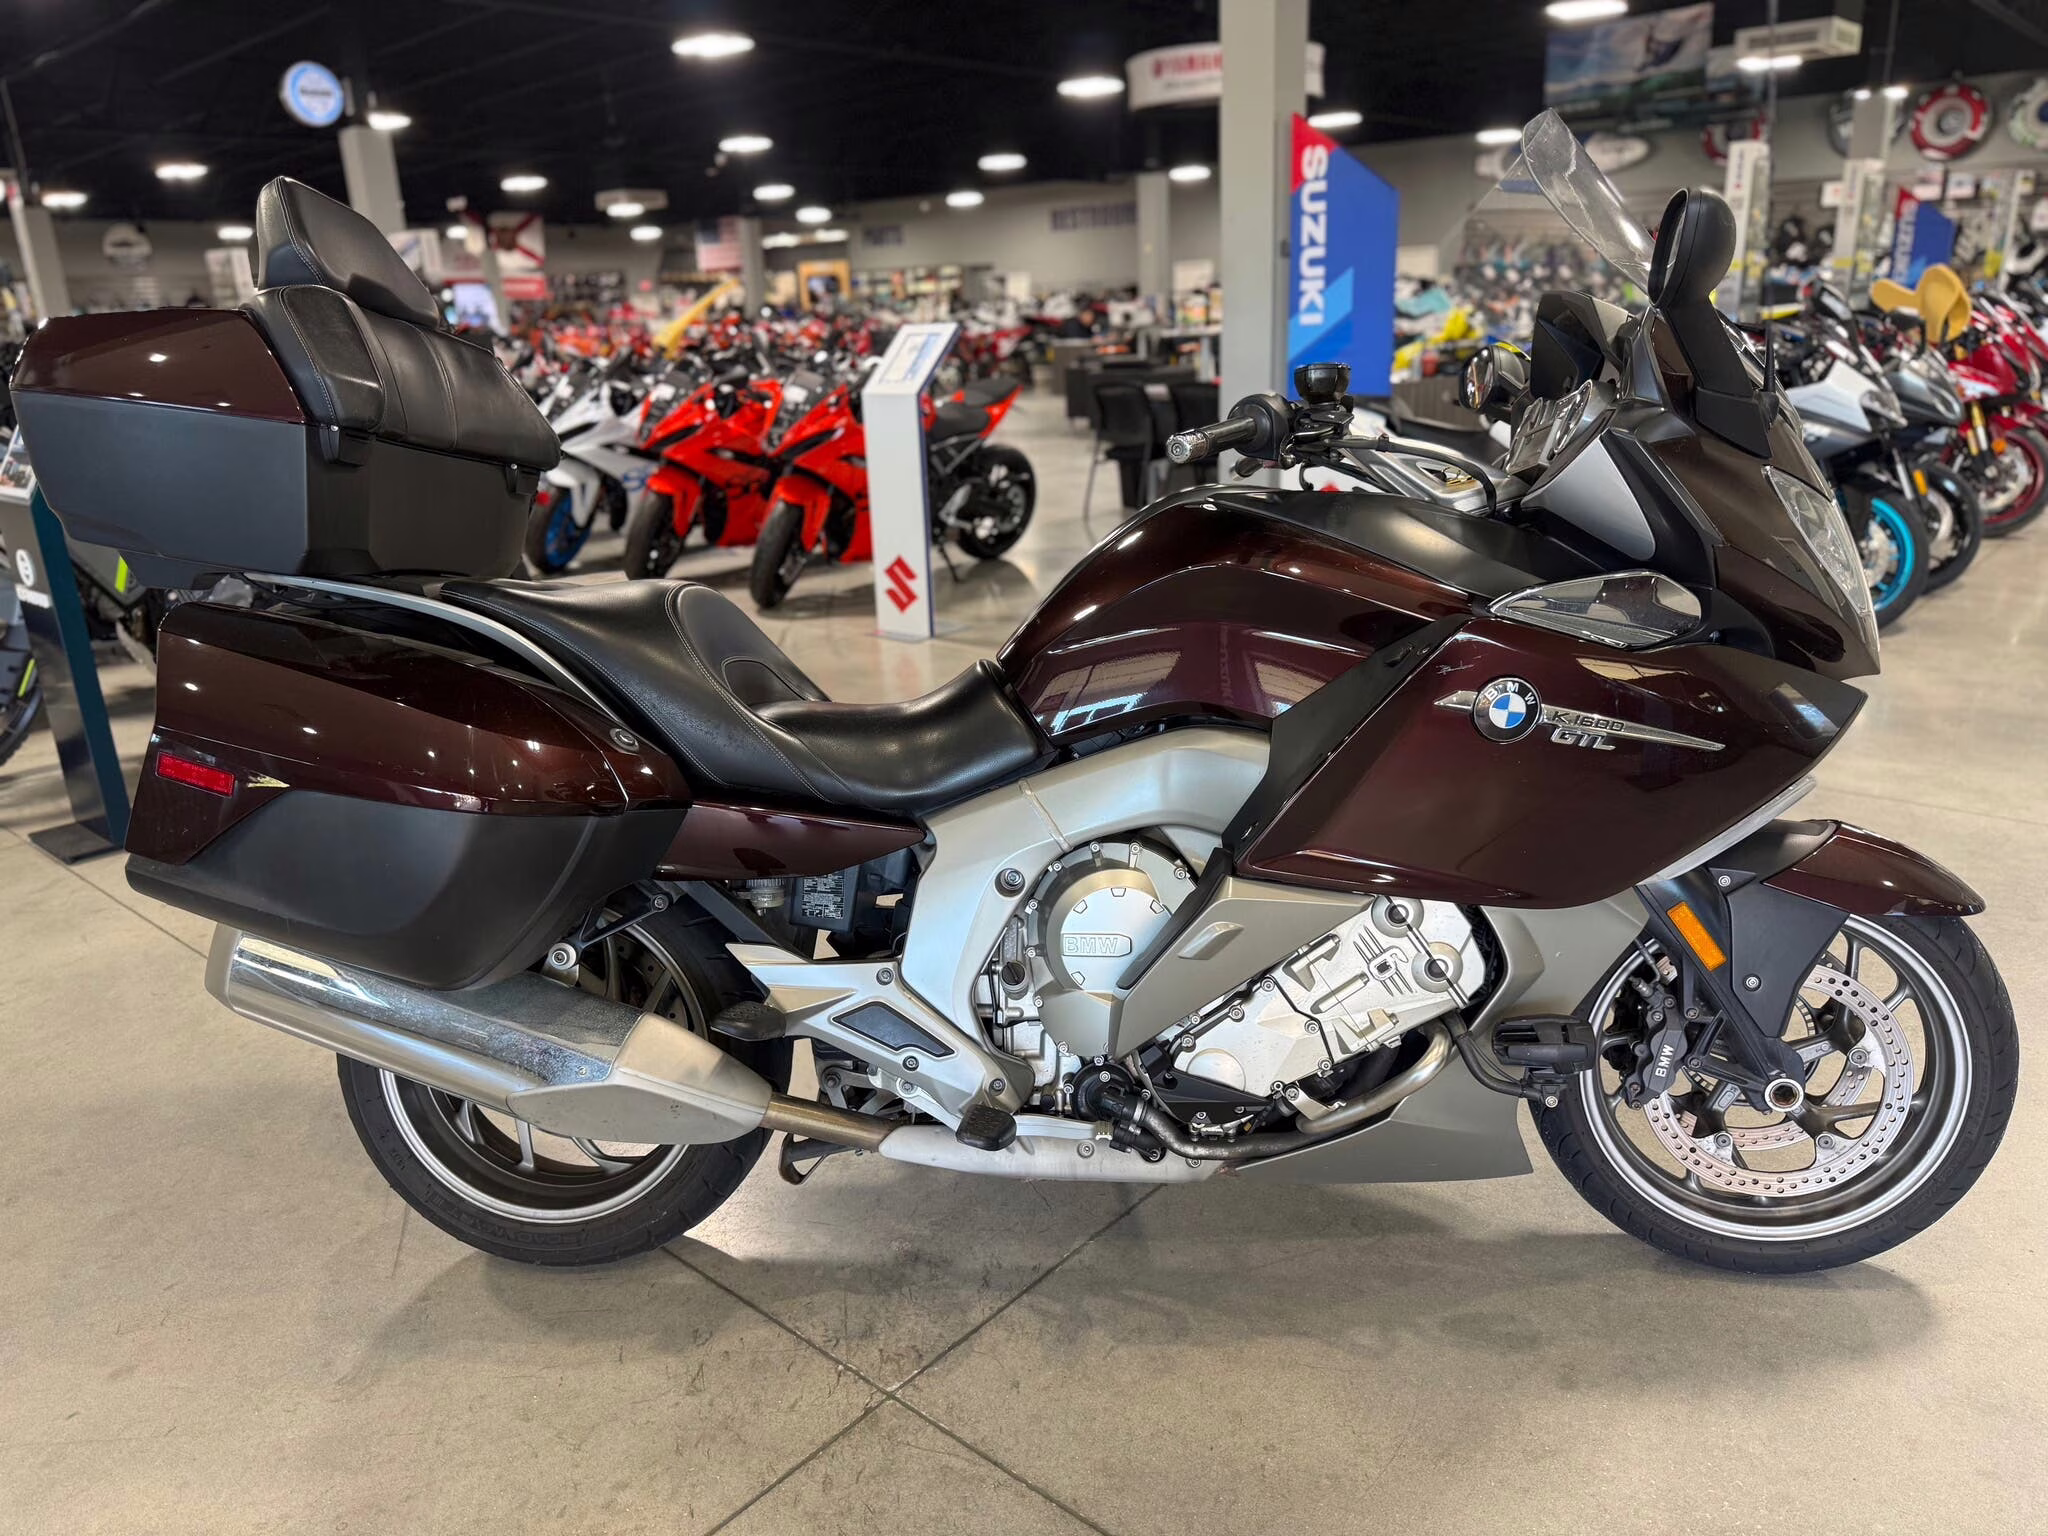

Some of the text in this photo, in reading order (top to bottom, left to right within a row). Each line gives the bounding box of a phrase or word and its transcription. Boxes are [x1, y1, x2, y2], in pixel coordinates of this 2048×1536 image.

[1299, 144, 1328, 326] SUZUKI
[1484, 681, 1536, 707] BMW
[1550, 727, 1616, 751] GTL
[1064, 936, 1118, 954] BMW
[1655, 1044, 1674, 1077] BMW
